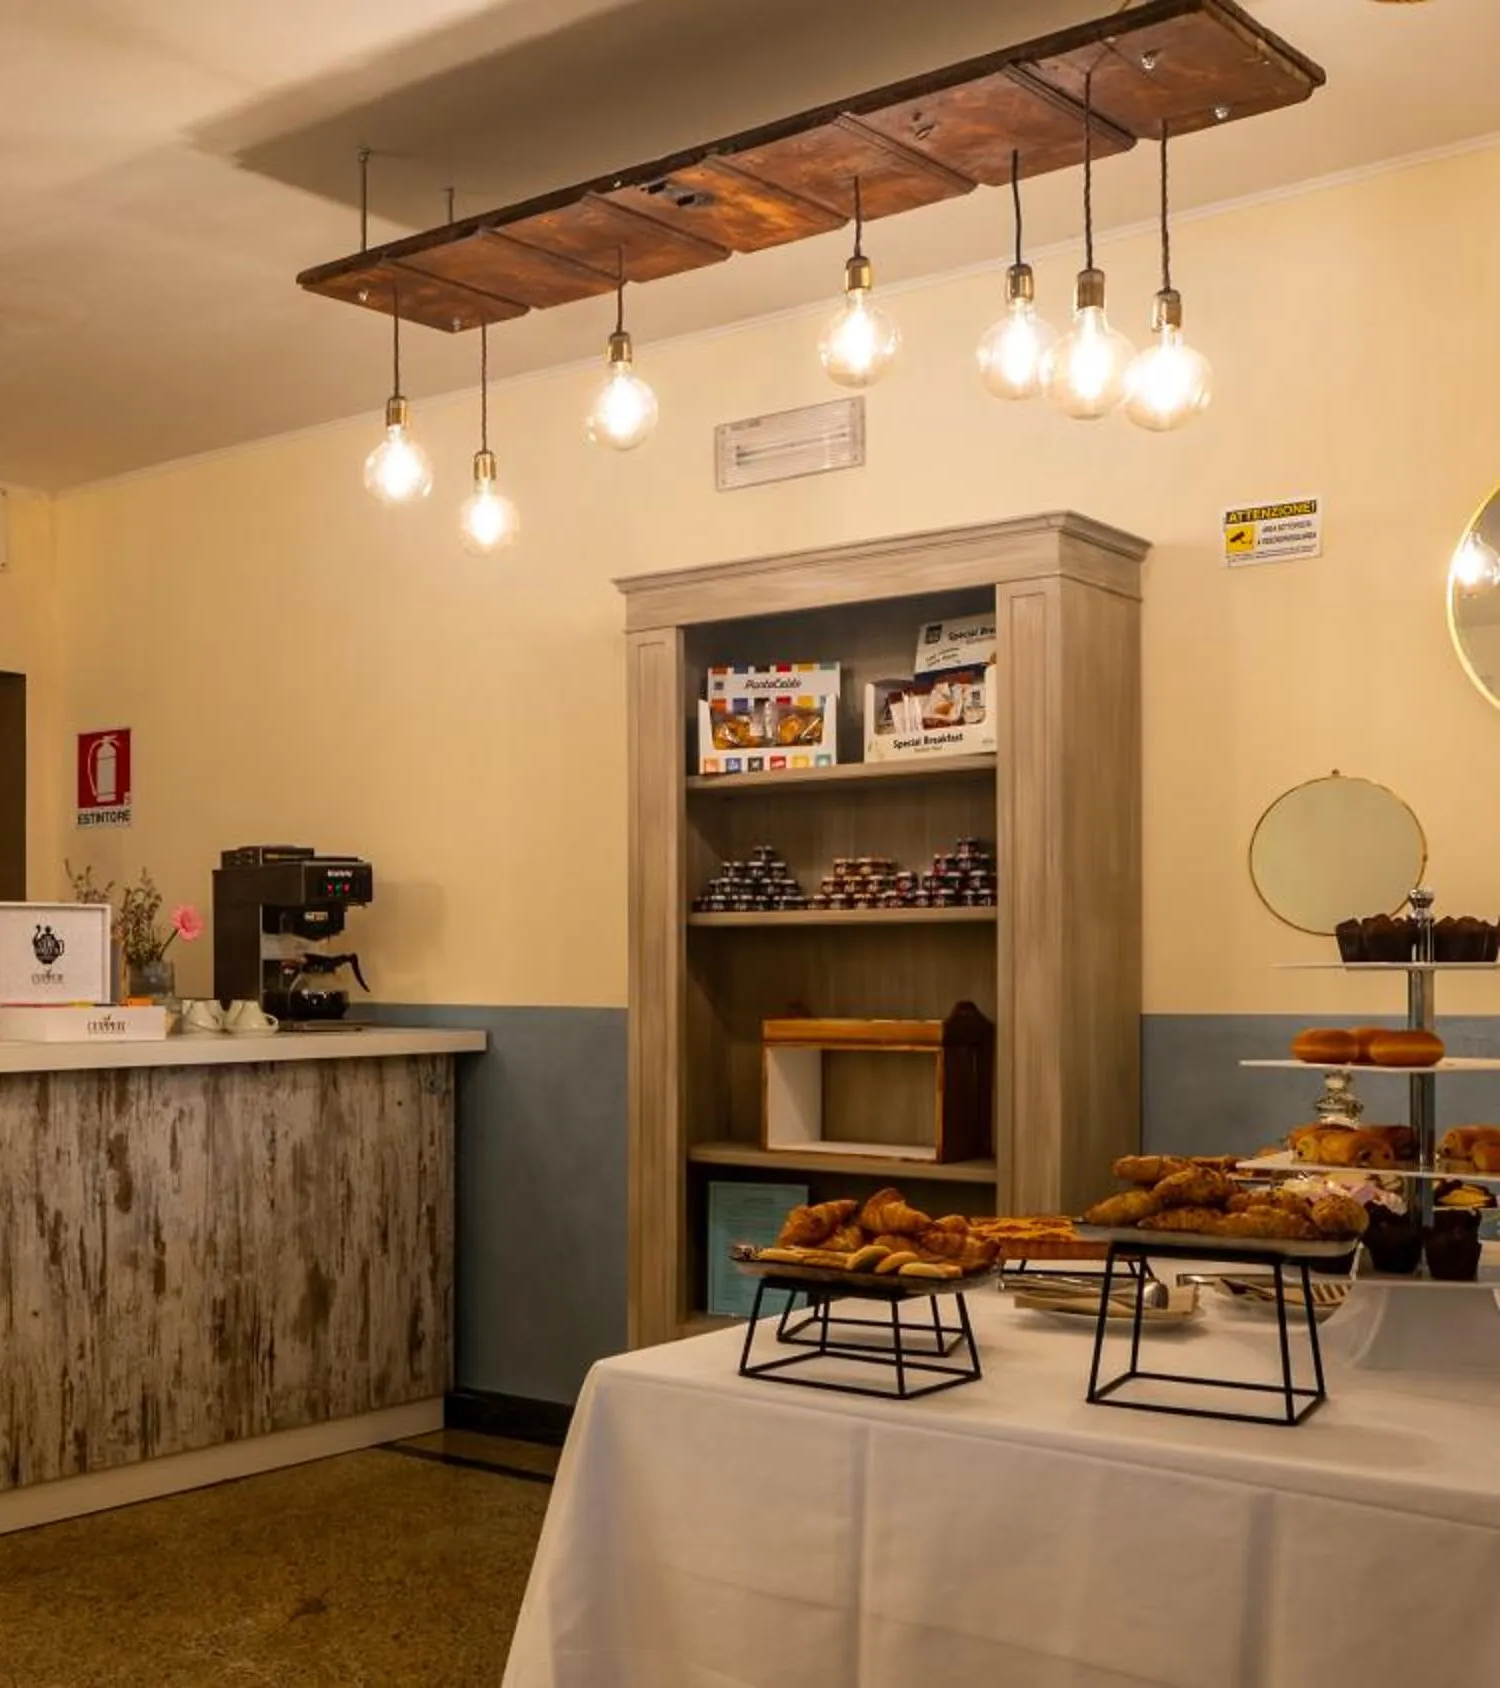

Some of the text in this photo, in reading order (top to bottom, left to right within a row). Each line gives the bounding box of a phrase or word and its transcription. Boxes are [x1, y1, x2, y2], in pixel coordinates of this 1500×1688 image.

[1228, 500, 1316, 523] ATTENZIONE!
[893, 737, 920, 750] Special
[923, 732, 964, 746] Breakfast
[77, 808, 131, 825] ESTINTORE
